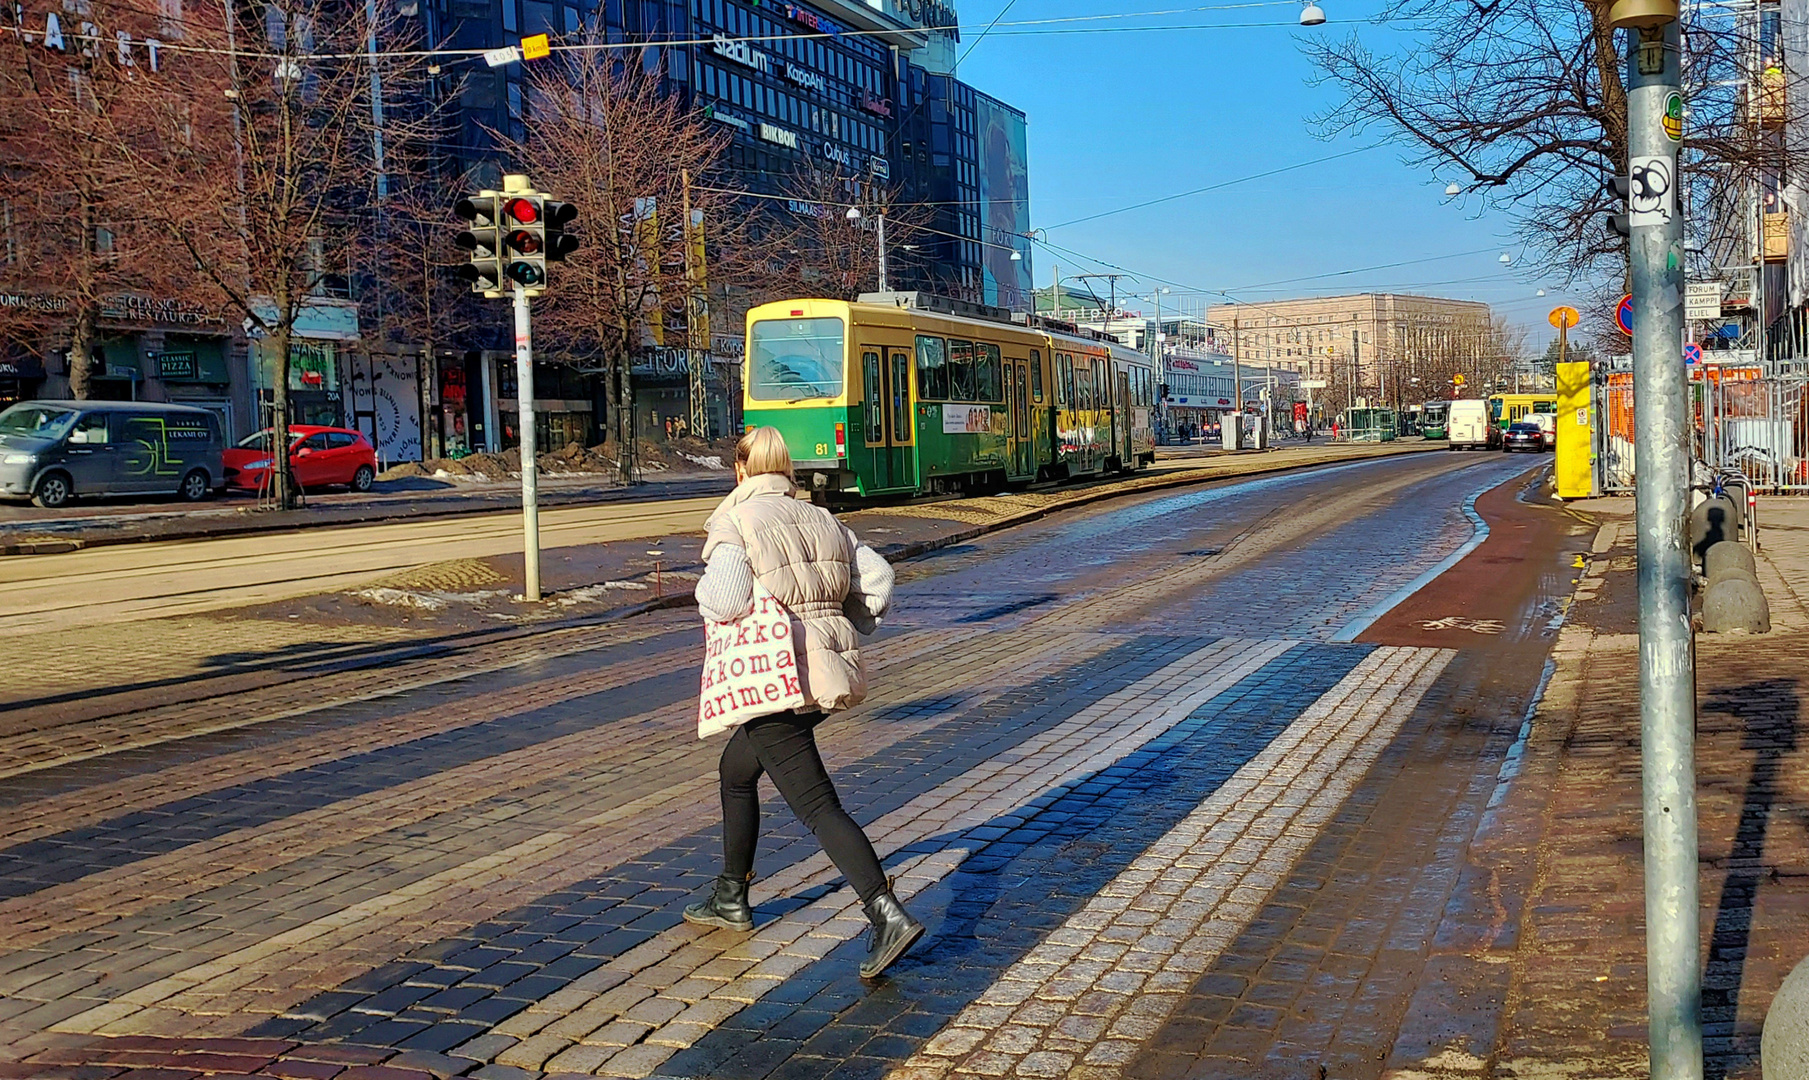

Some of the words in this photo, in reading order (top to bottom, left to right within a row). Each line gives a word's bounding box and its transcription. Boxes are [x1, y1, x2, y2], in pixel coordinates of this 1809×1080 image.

[713, 32, 767, 73] stadium
[786, 62, 823, 92] KappAhl
[824, 142, 850, 165] Cubus
[1688, 286, 1715, 294] FORUM
[162, 362, 191, 371] PIZZA
[815, 443, 828, 455] 81
